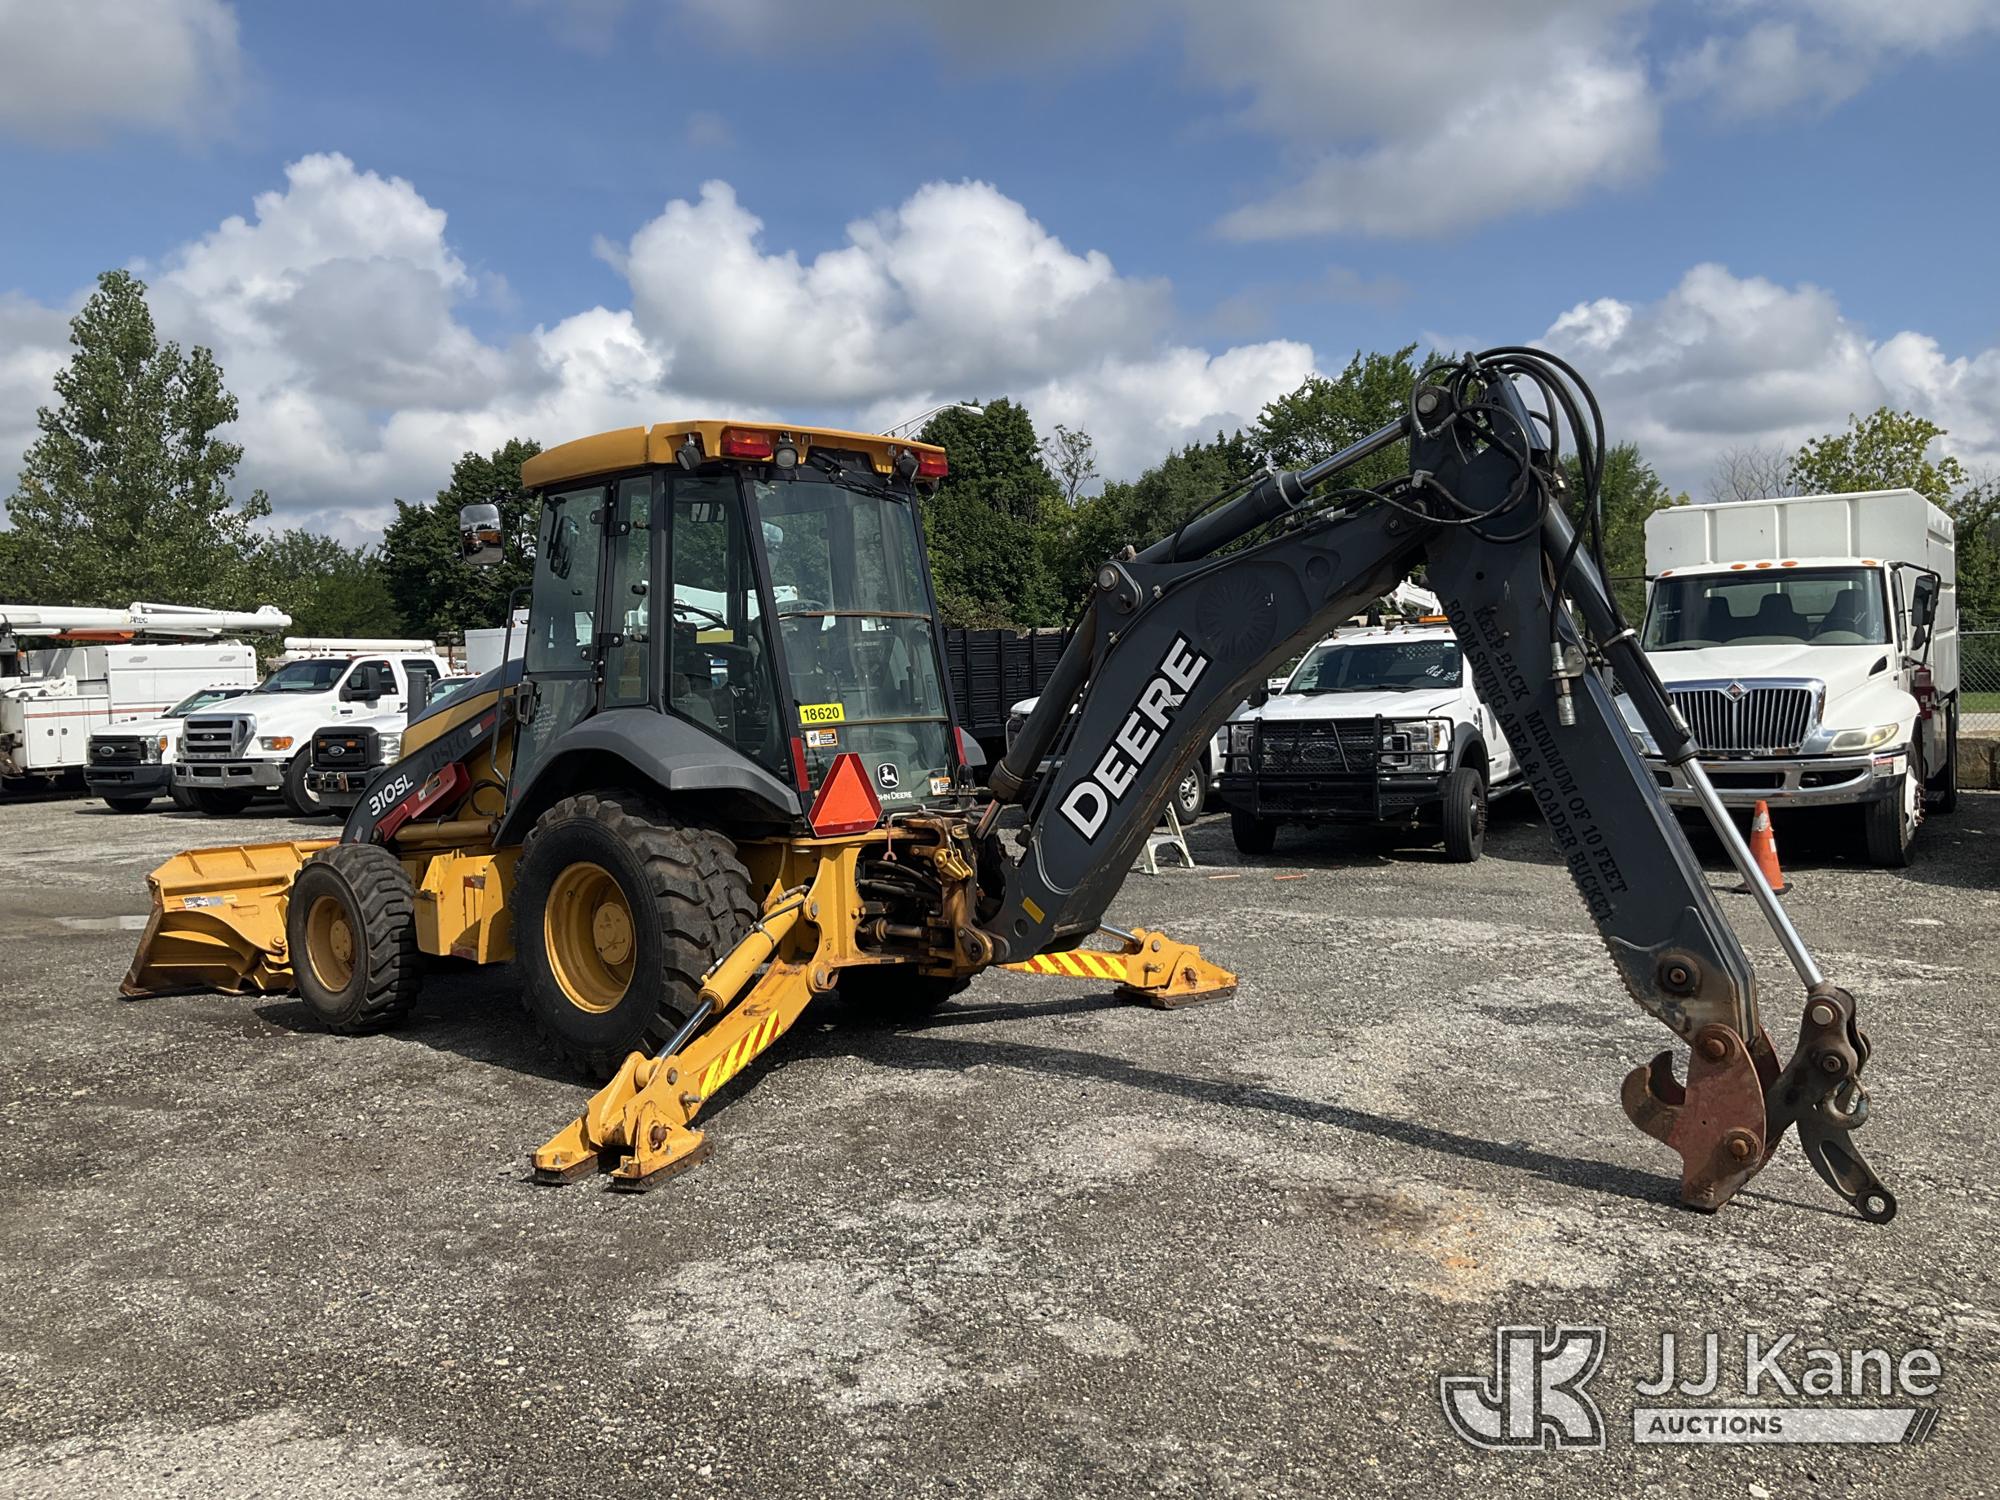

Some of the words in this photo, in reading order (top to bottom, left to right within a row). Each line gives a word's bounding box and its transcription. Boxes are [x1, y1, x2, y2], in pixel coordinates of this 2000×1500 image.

[1470, 651, 1509, 710] SWING
[803, 707, 840, 721] 18620
[1060, 637, 1208, 839] DEERE
[1500, 712, 1532, 760] AREA
[1473, 605, 1504, 649] KEEP
[1495, 652, 1530, 701] BACK
[1524, 709, 1578, 797] MINIMUM
[1569, 797, 1592, 820] OF
[1583, 825, 1602, 844] 10
[1593, 846, 1628, 893] FEET
[1525, 761, 1541, 776] &
[368, 774, 414, 816] 310SL
[890, 791, 912, 799] DEERE
[1532, 777, 1577, 850] LOADER
[1568, 850, 1614, 922] BUCKET
